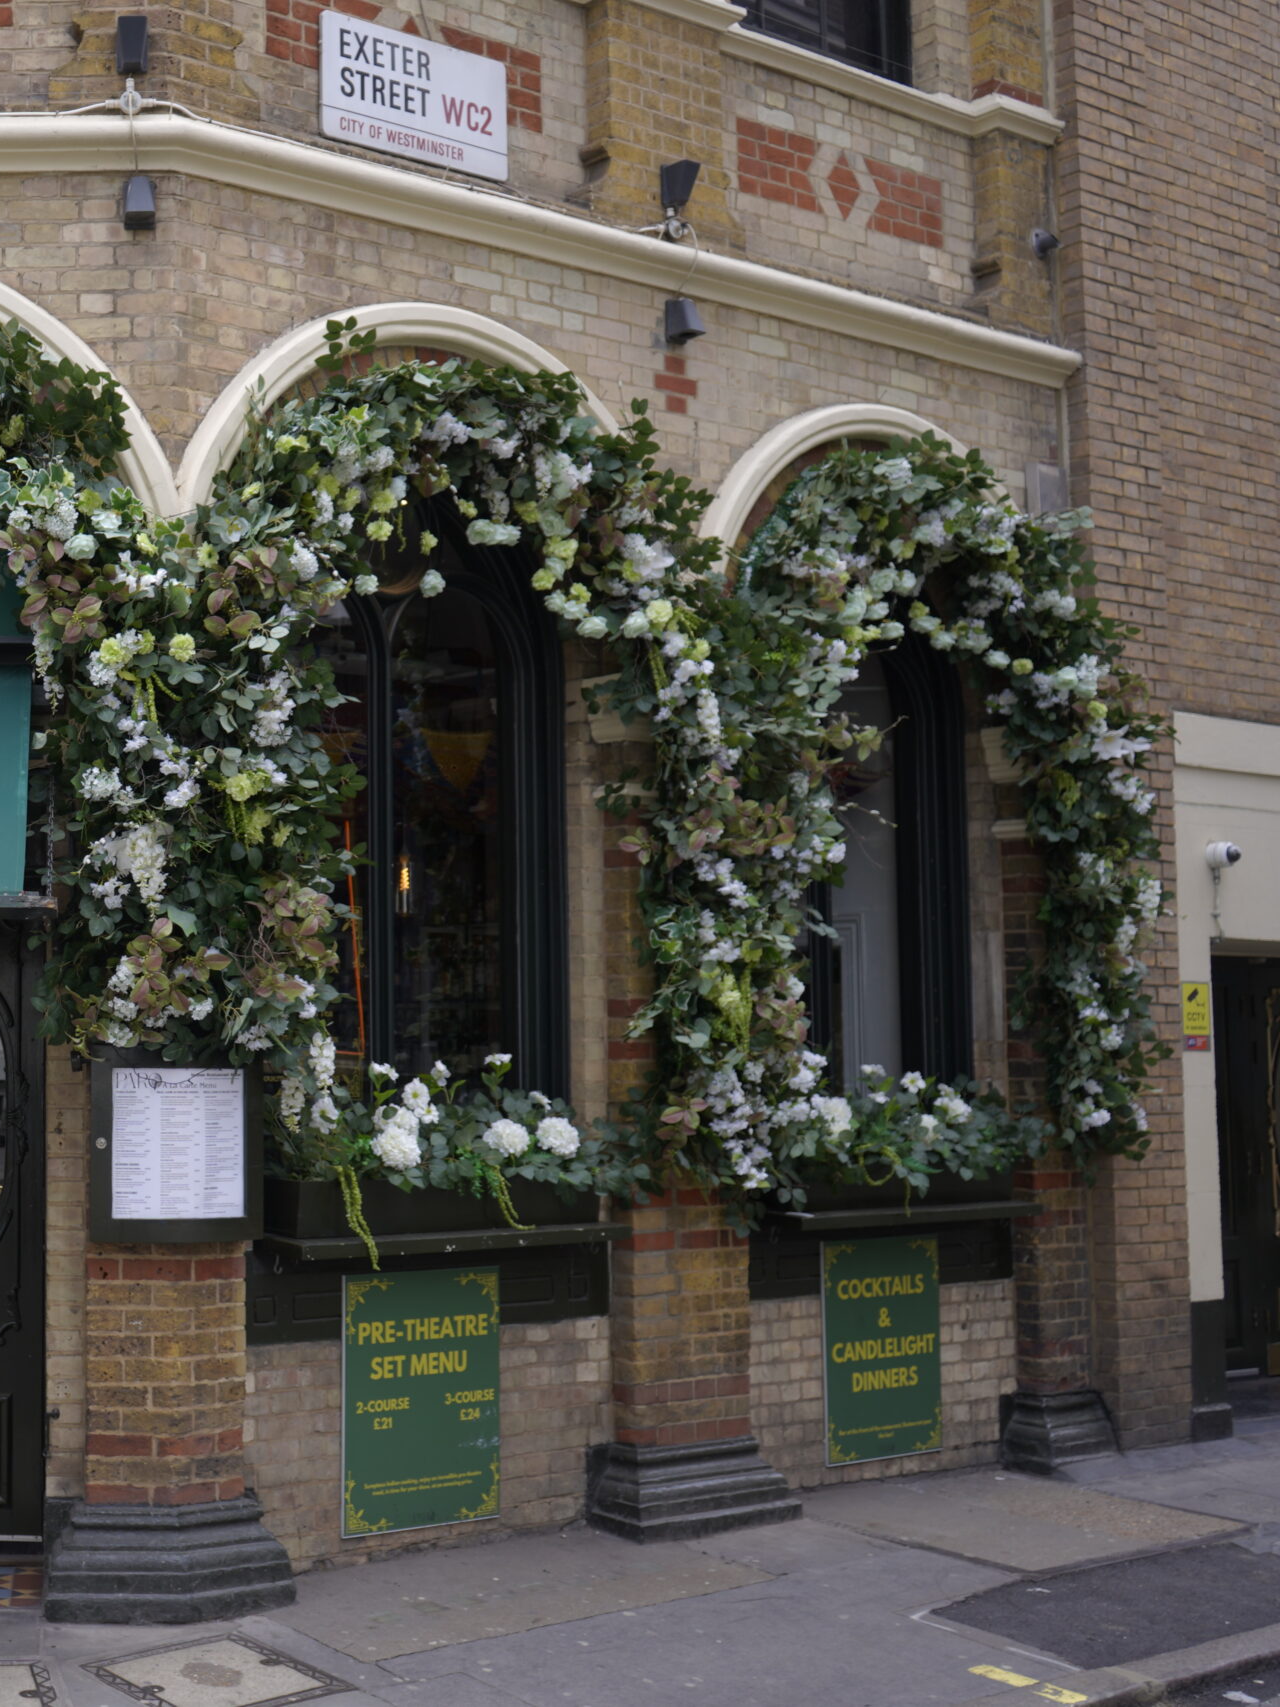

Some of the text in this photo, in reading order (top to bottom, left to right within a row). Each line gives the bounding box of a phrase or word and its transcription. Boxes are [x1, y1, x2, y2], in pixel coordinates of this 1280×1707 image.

[339, 27, 431, 82] EXETER
[340, 66, 493, 136] STREET WC2
[339, 116, 464, 162] CITY OF WESTMINSTER
[836, 1273, 924, 1300] COCKTAILS
[357, 1313, 488, 1346] PRE-THEATRE
[878, 1307, 891, 1327] &
[831, 1333, 935, 1363] CANDLELIGHT
[370, 1349, 468, 1380] SET MENU
[851, 1365, 919, 1393] DINNERS
[356, 1397, 411, 1414] 2-COURSE
[444, 1388, 495, 1405] 3-COURSE
[373, 1417, 393, 1430] £21
[459, 1407, 481, 1421] £24
